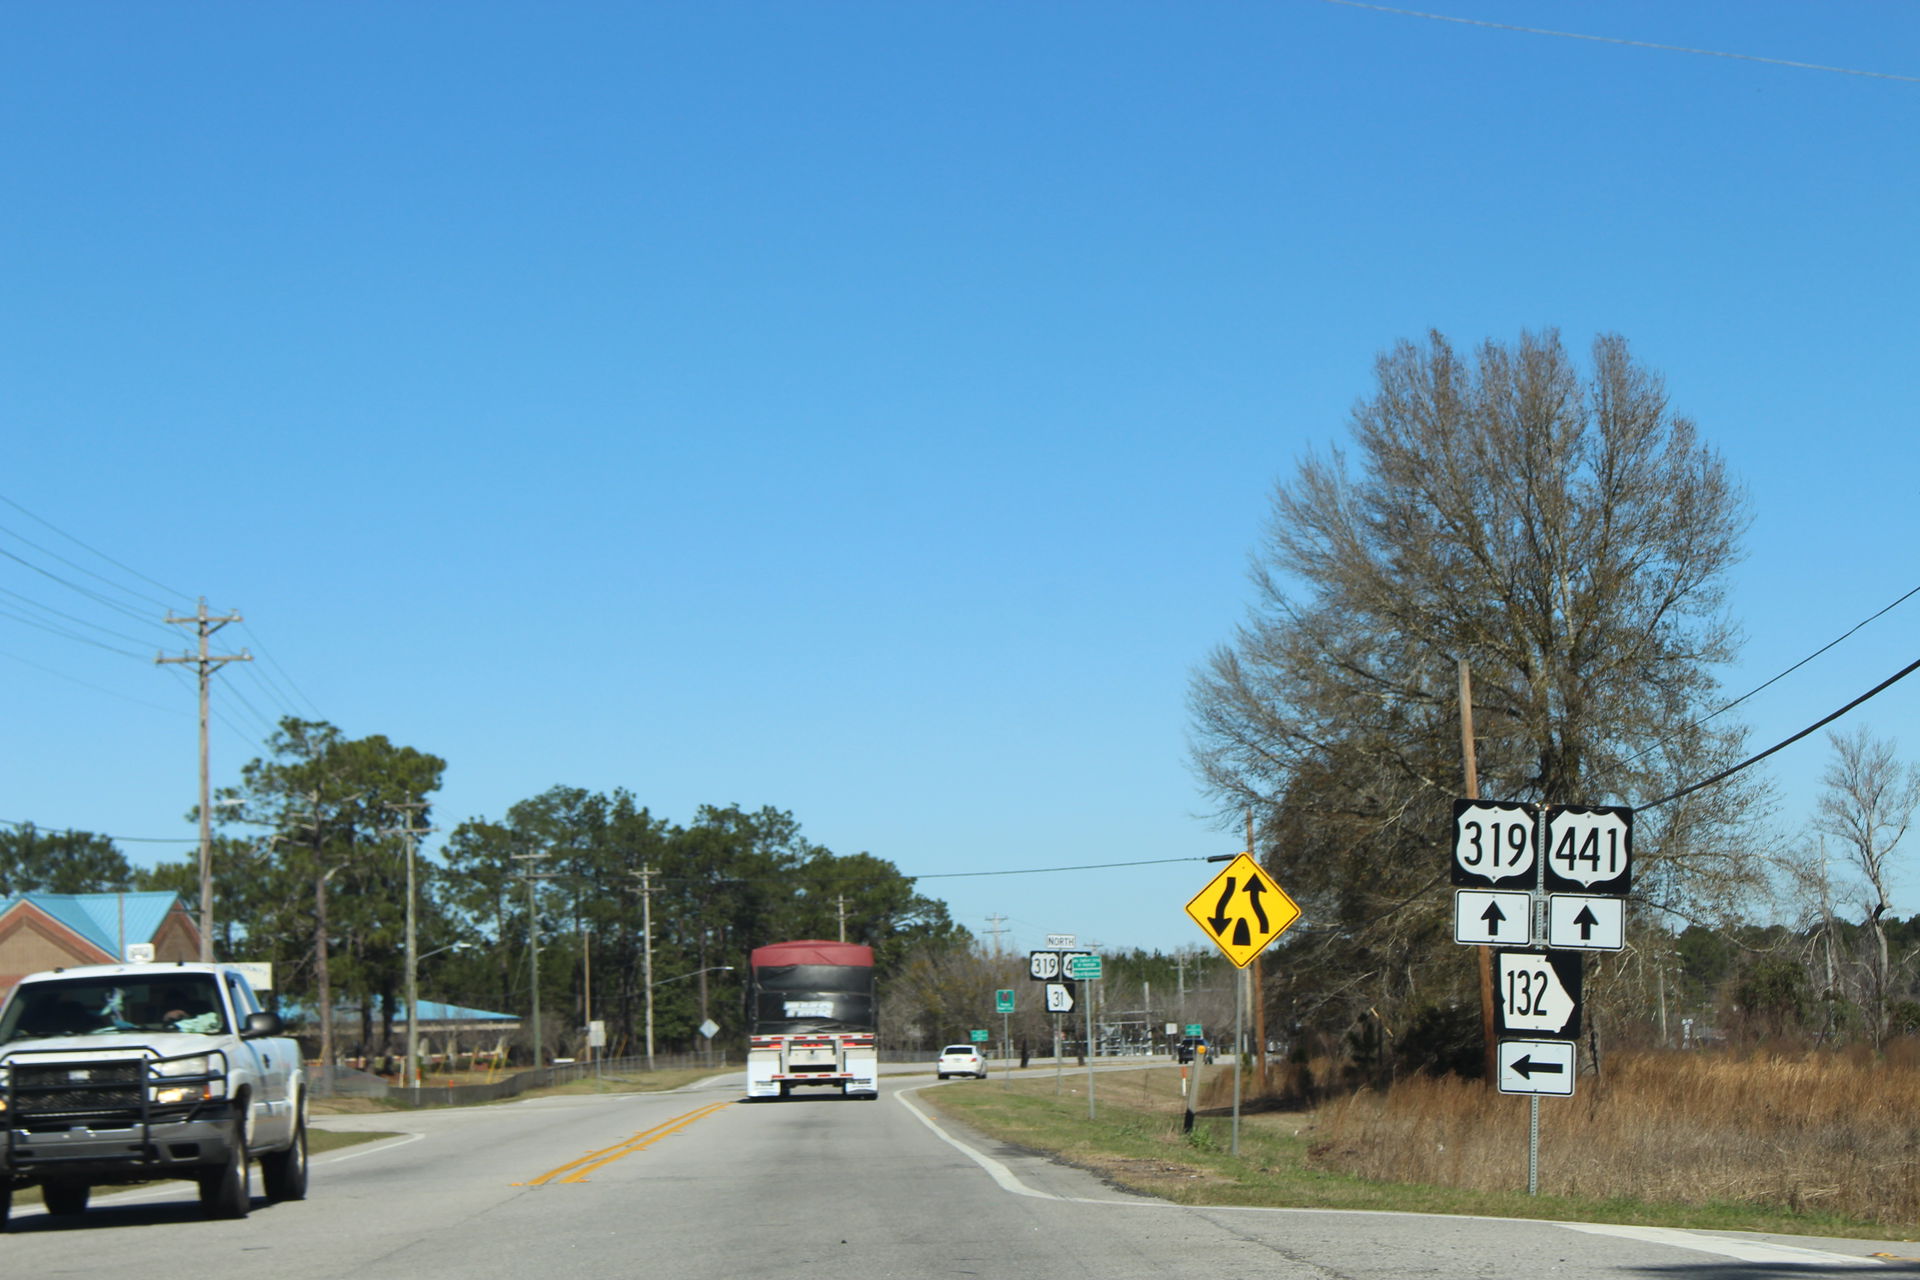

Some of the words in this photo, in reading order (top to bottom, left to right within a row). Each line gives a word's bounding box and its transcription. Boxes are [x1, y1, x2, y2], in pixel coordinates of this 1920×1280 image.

[1464, 820, 1527, 868] 319
[1555, 826, 1618, 874] 441
[1048, 937, 1074, 946] NORTH
[1034, 958, 1057, 974] 319
[1052, 991, 1064, 1007] 31
[1507, 969, 1548, 1017] 132
